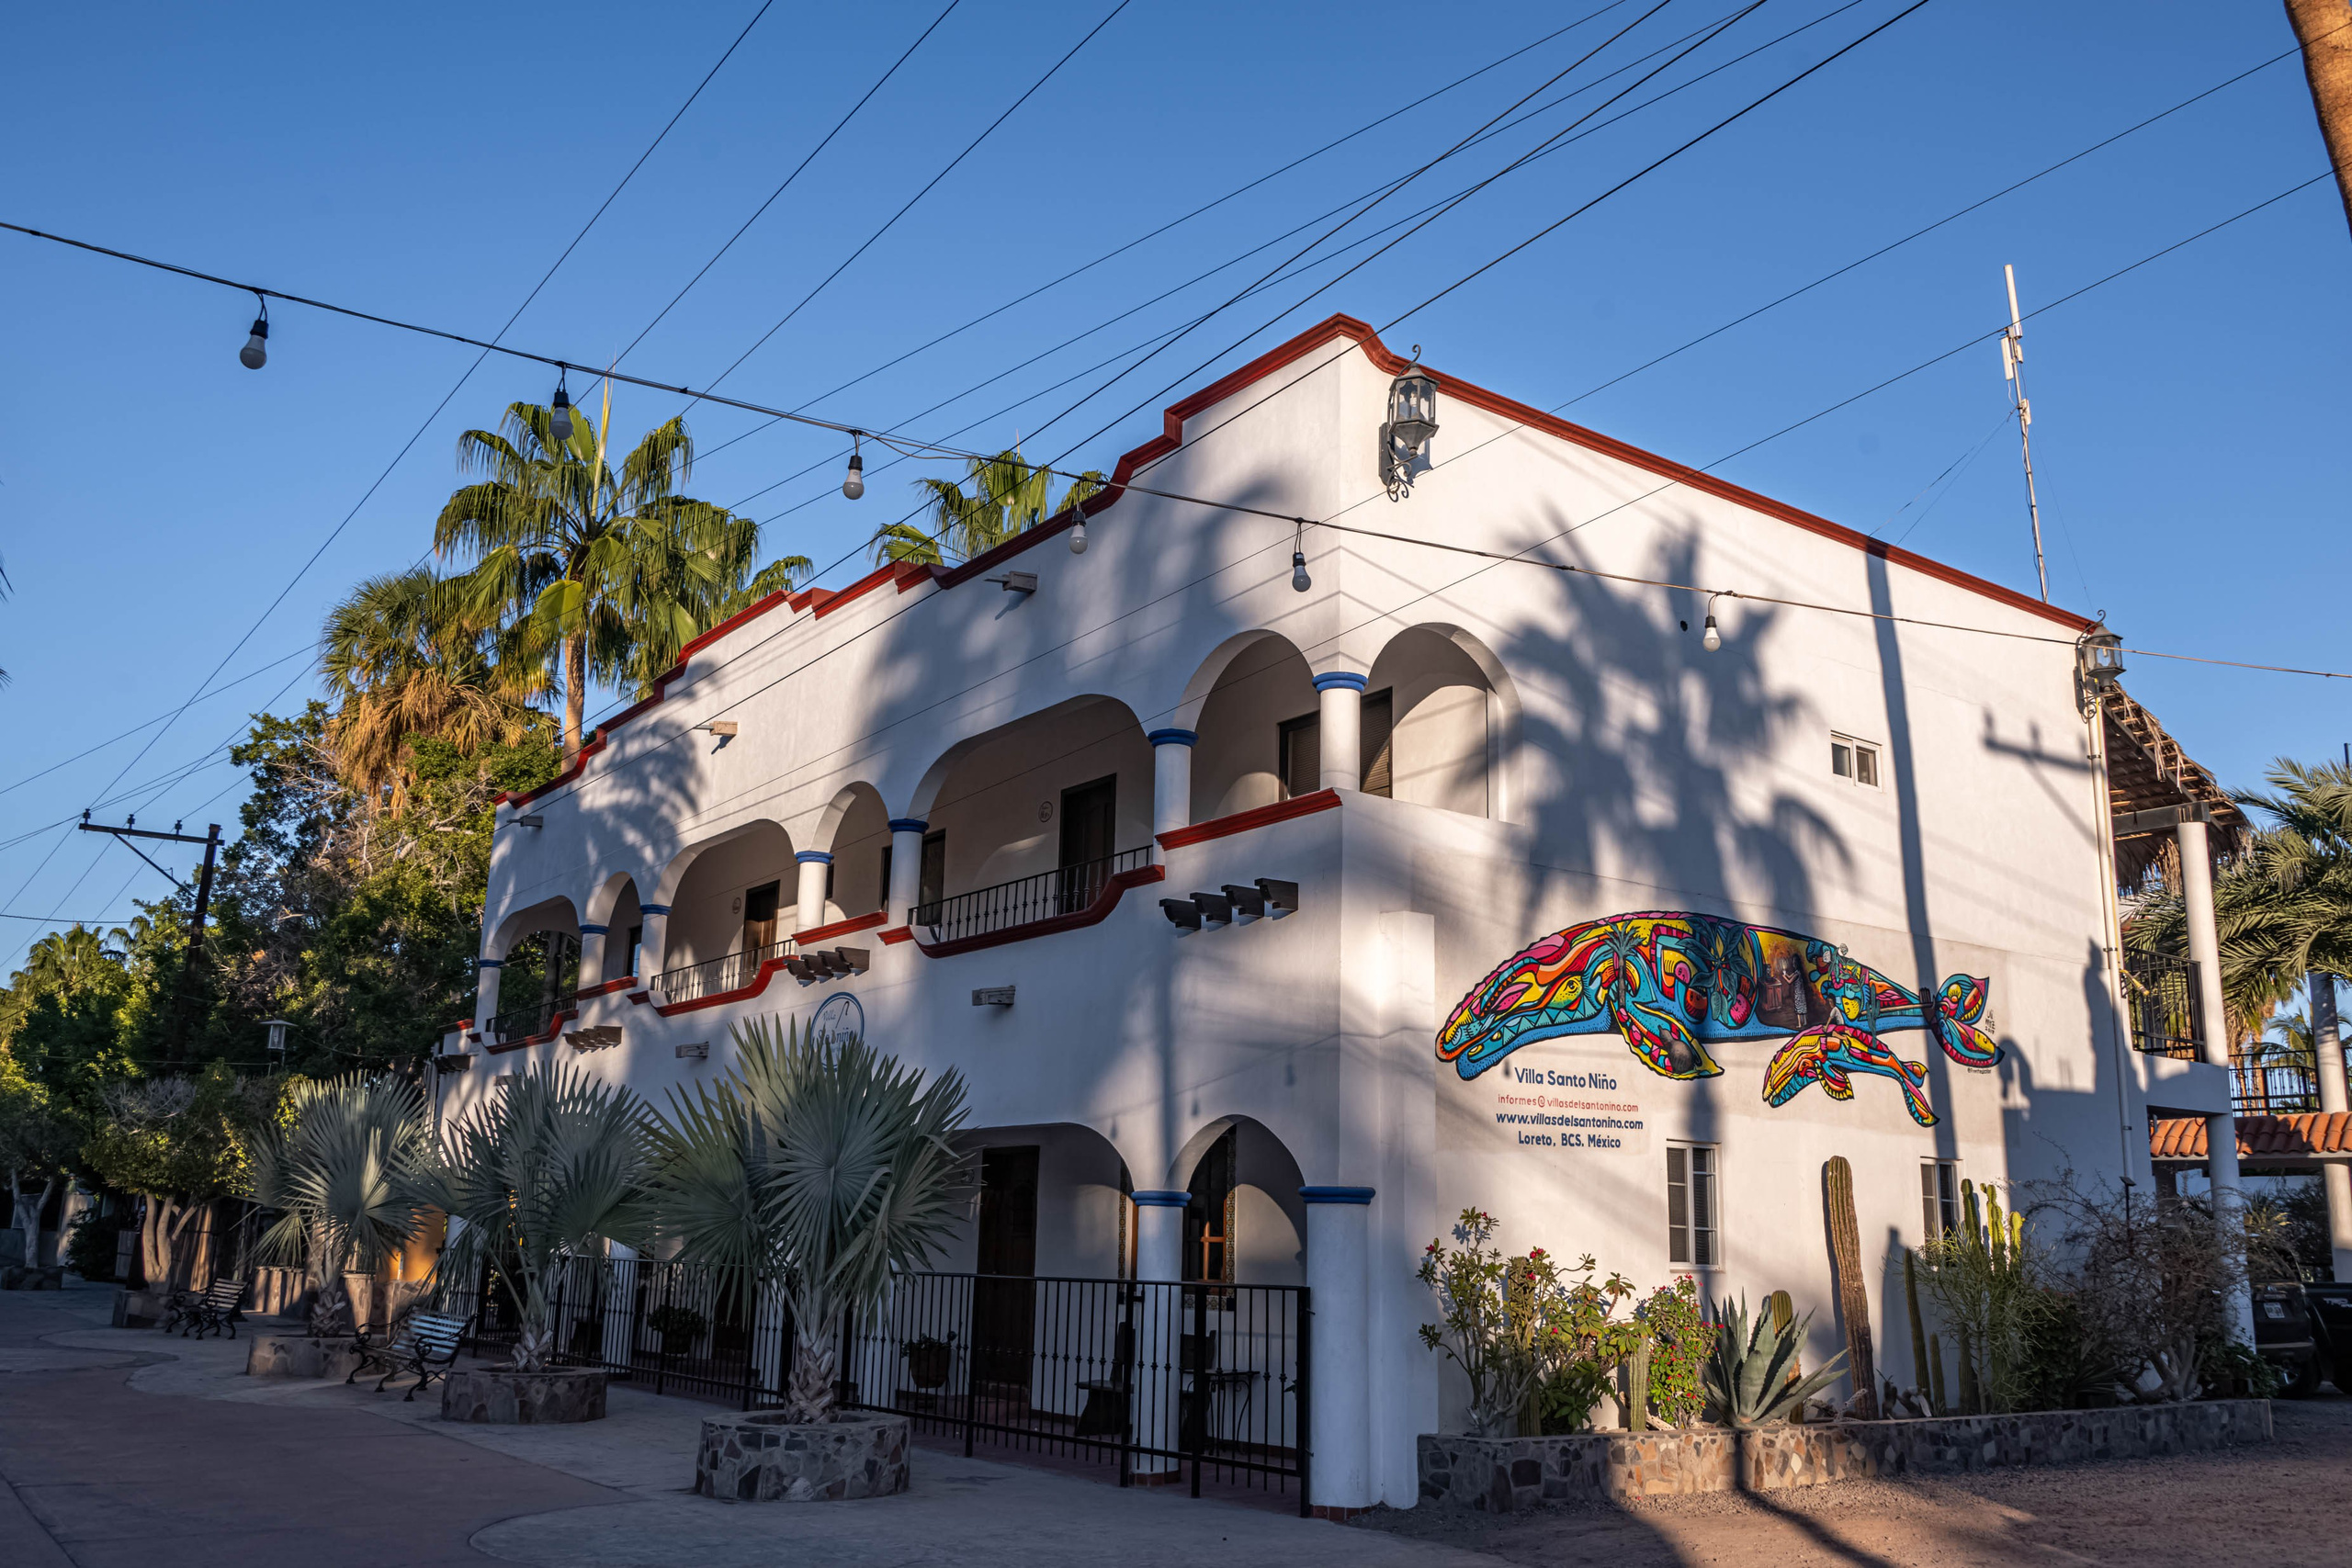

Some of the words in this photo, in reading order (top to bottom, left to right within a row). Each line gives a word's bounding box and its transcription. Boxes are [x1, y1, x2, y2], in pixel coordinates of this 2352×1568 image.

[1514, 1066, 1544, 1085] Villa
[1547, 1070, 1587, 1089] Santo
[1589, 1073, 1617, 1090] Niño
[1496, 1112, 1644, 1130] www.villasdelsantonino.com
[1518, 1131, 1556, 1147] Loreto,
[1561, 1133, 1585, 1147] BCS.
[1588, 1133, 1621, 1148] México
